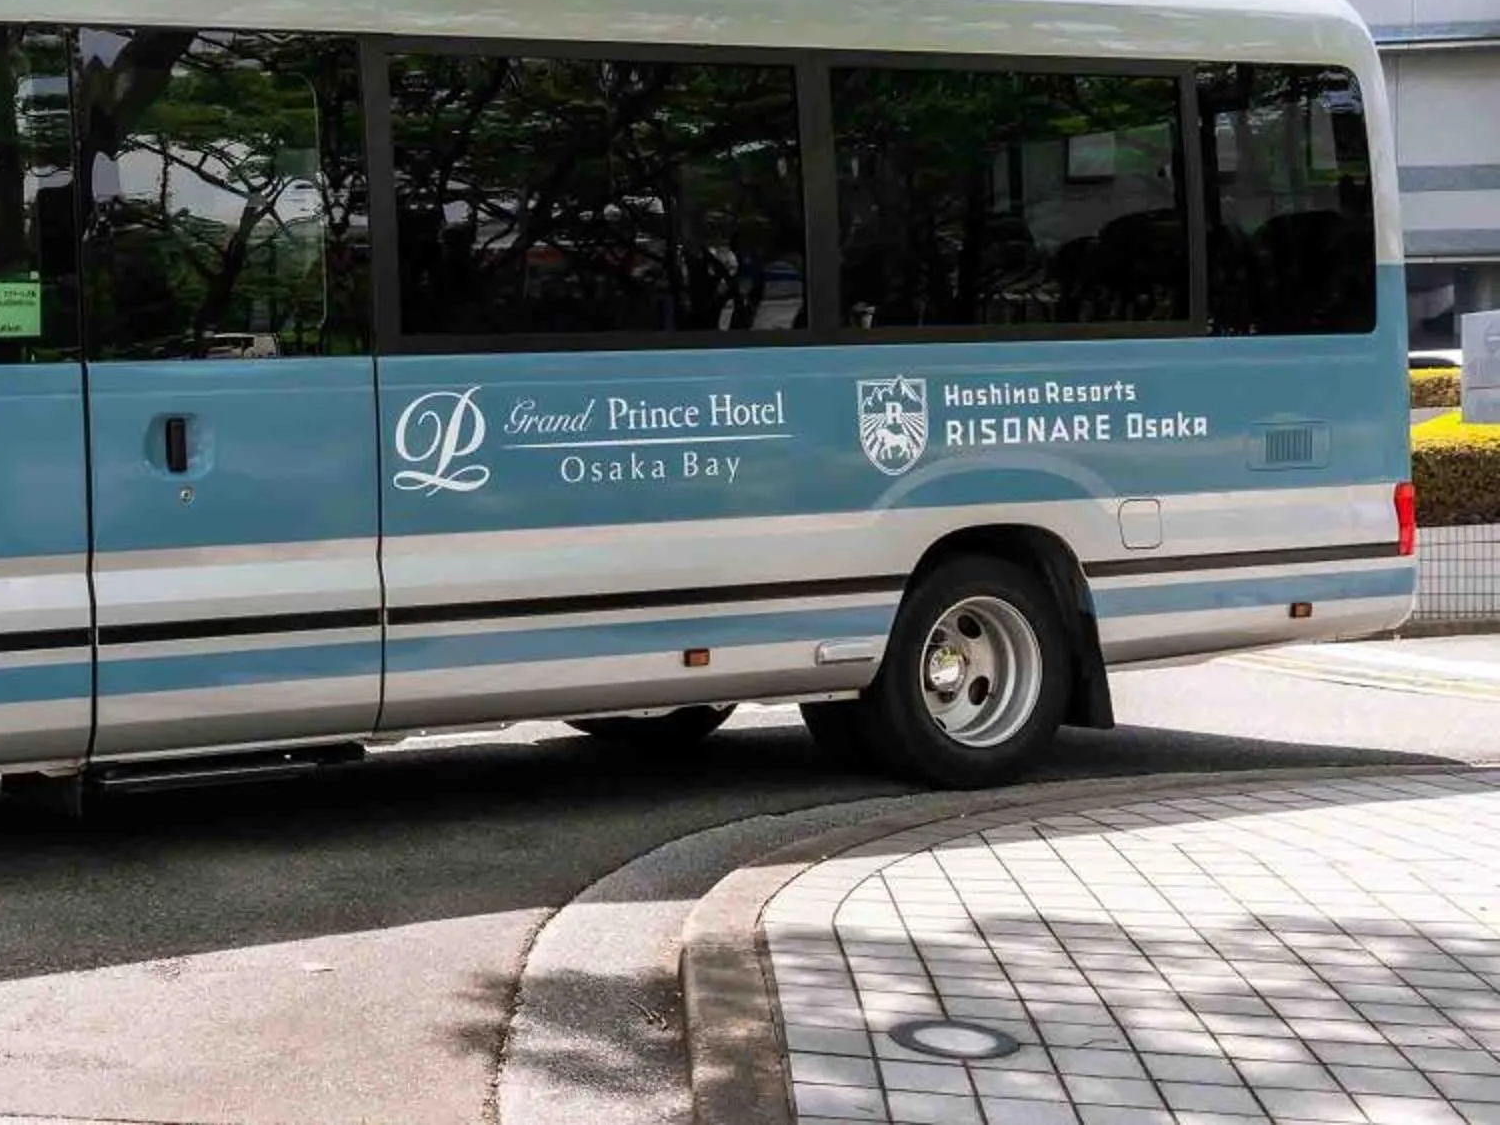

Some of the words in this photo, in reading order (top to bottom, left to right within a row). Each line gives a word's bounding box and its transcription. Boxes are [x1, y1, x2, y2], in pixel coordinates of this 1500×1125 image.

[944, 383, 1039, 407] Hoshino
[1045, 380, 1137, 404] Resorts
[504, 398, 595, 434] Grand
[608, 397, 699, 430] Prince
[709, 391, 787, 427] Hotel
[946, 414, 1111, 447] RISONARE
[1127, 411, 1207, 440] Osaka
[561, 452, 666, 483] Osaka
[683, 451, 741, 483] Bay
